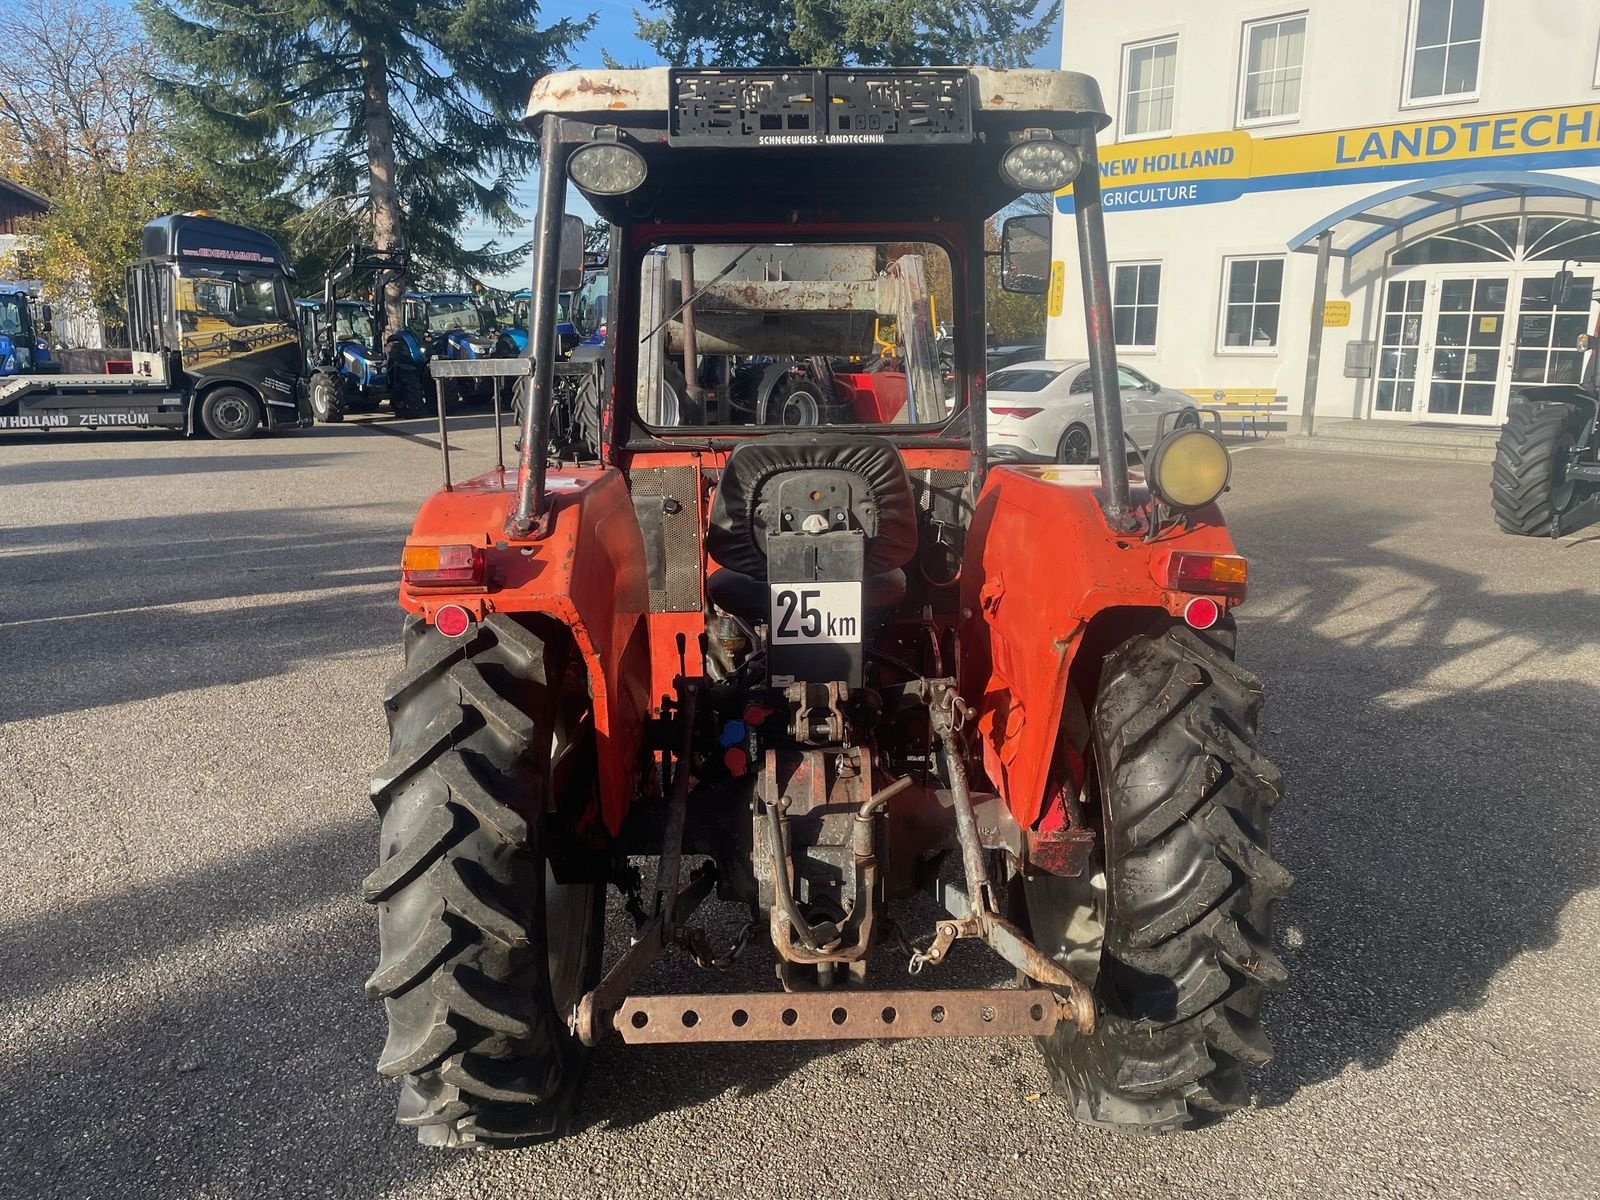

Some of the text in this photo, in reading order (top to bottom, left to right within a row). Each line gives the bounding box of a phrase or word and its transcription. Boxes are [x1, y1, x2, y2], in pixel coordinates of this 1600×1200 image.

[759, 135, 817, 145] SCHNEEWEISS
[825, 135, 884, 144] LANDTECHNIK
[1335, 111, 1600, 164] LANDTECH
[1098, 147, 1234, 177] NEW HOLLAND
[1101, 185, 1197, 206] GRICULTURE
[10, 415, 69, 427] HOLLAND
[79, 413, 149, 426] ZENTRUM
[776, 590, 856, 638] 25 km
